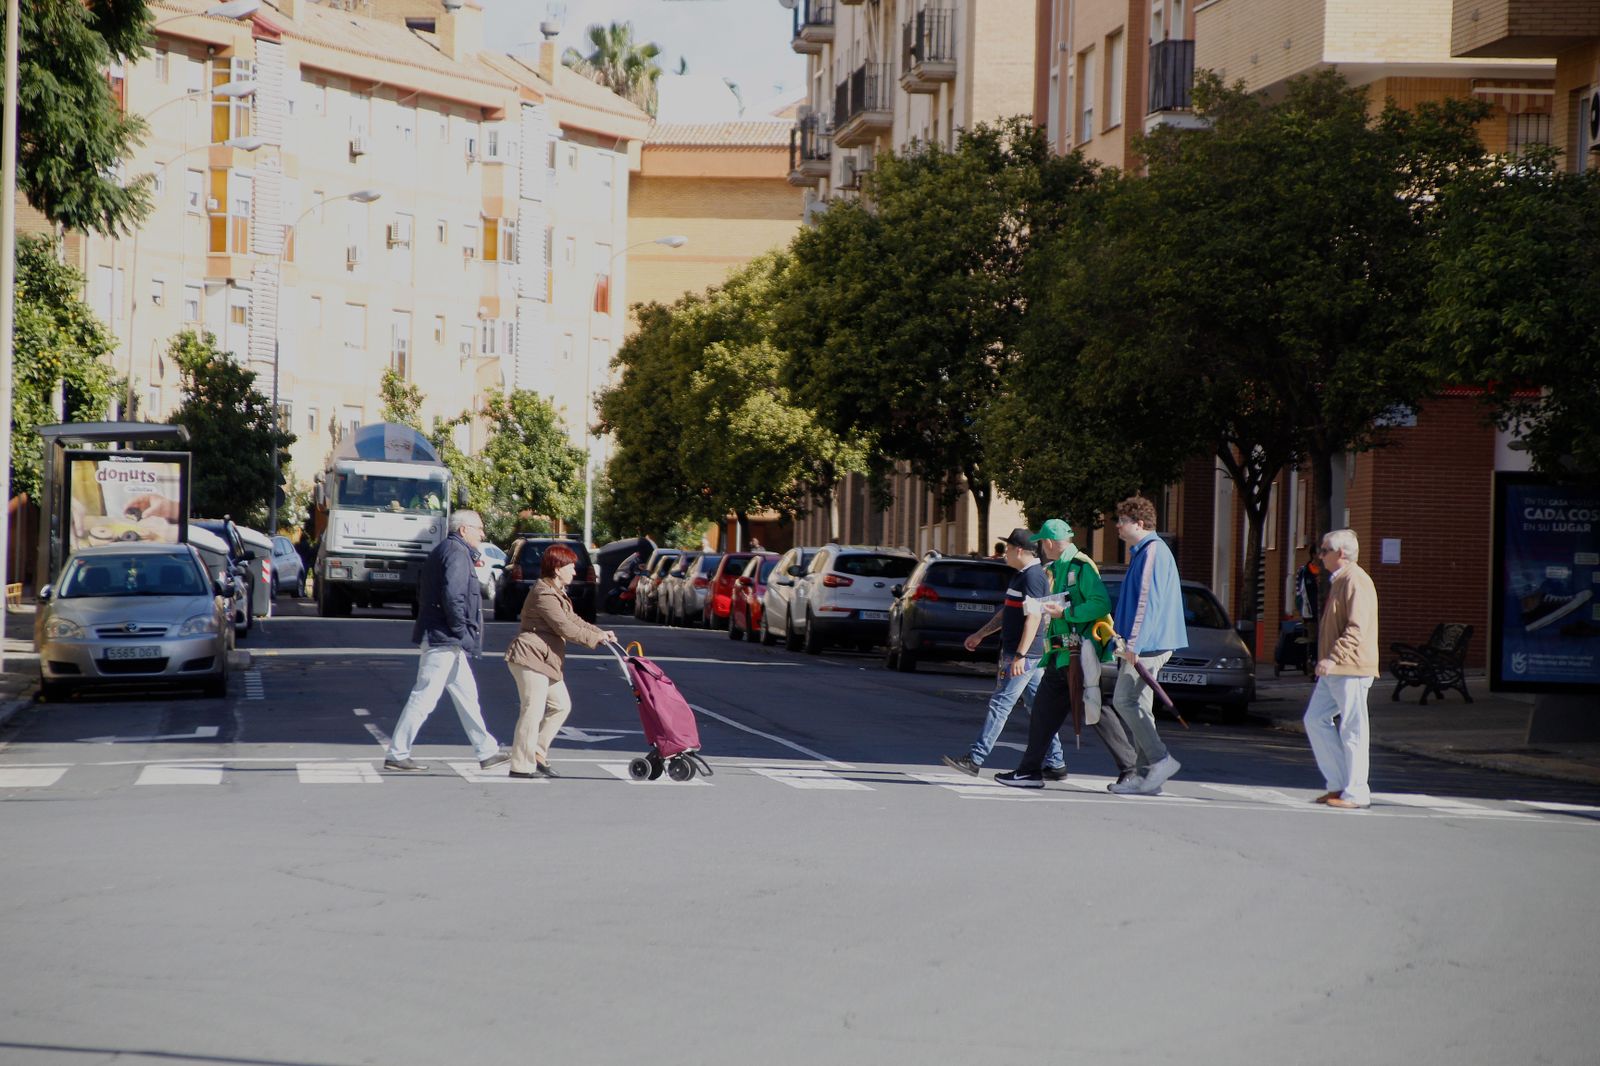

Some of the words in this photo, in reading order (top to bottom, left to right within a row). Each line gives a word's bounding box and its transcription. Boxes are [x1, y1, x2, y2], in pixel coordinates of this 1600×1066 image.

[98, 467, 156, 483] donuts
[1524, 507, 1566, 521] CADA
[1568, 508, 1600, 522] COS
[1523, 523, 1535, 531] EN
[1538, 523, 1550, 531] SU
[1552, 523, 1592, 532] LUGAR
[1162, 673, 1169, 681] H
[1171, 673, 1194, 682] 6547
[1197, 674, 1203, 683] Z
